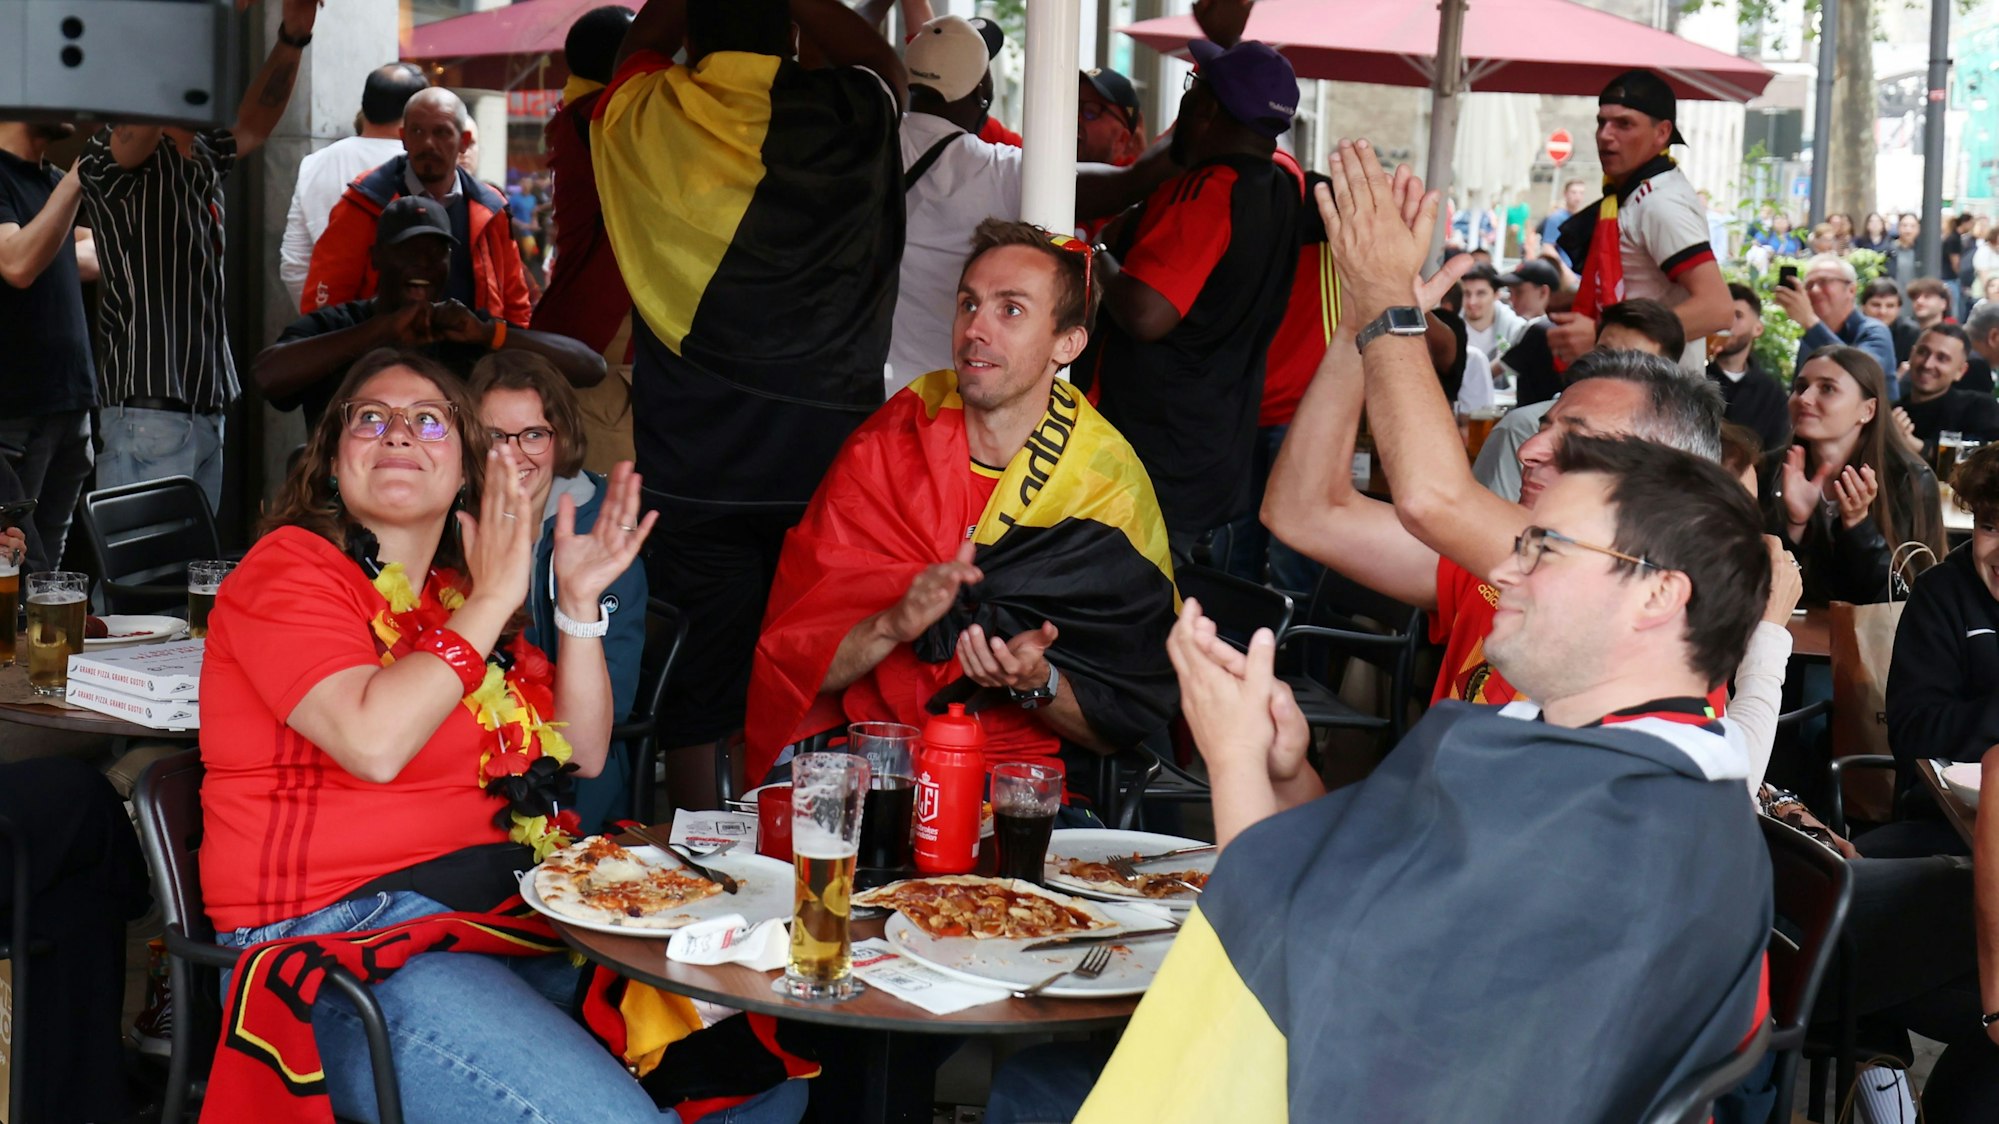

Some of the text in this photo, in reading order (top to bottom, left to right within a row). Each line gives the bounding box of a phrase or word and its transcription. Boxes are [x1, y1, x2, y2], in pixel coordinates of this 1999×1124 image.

[79, 665, 146, 688] GRANDE PIZZA, GRANDE GUSTO!
[77, 690, 145, 714] GRANDE PIZZA, GRANDE GUSTO!
